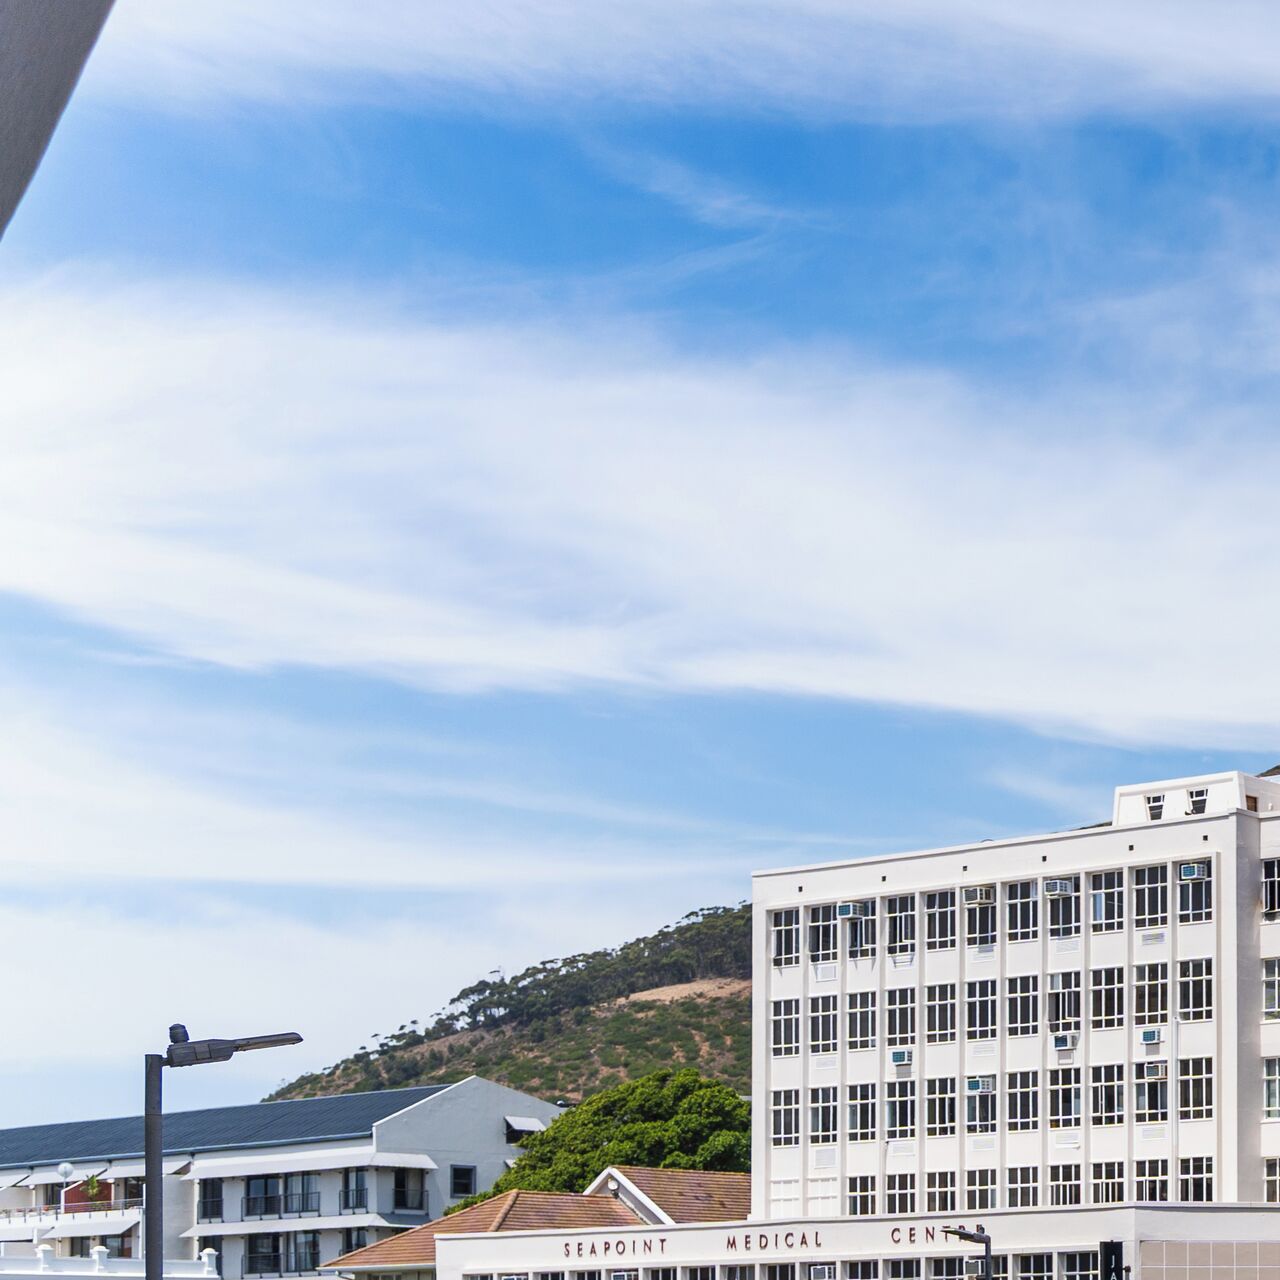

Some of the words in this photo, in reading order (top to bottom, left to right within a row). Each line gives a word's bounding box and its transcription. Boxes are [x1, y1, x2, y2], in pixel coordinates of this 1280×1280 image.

[564, 1238, 667, 1257] SEAPOINT
[726, 1231, 822, 1251] MEDICAL
[891, 1223, 985, 1244] CENT
